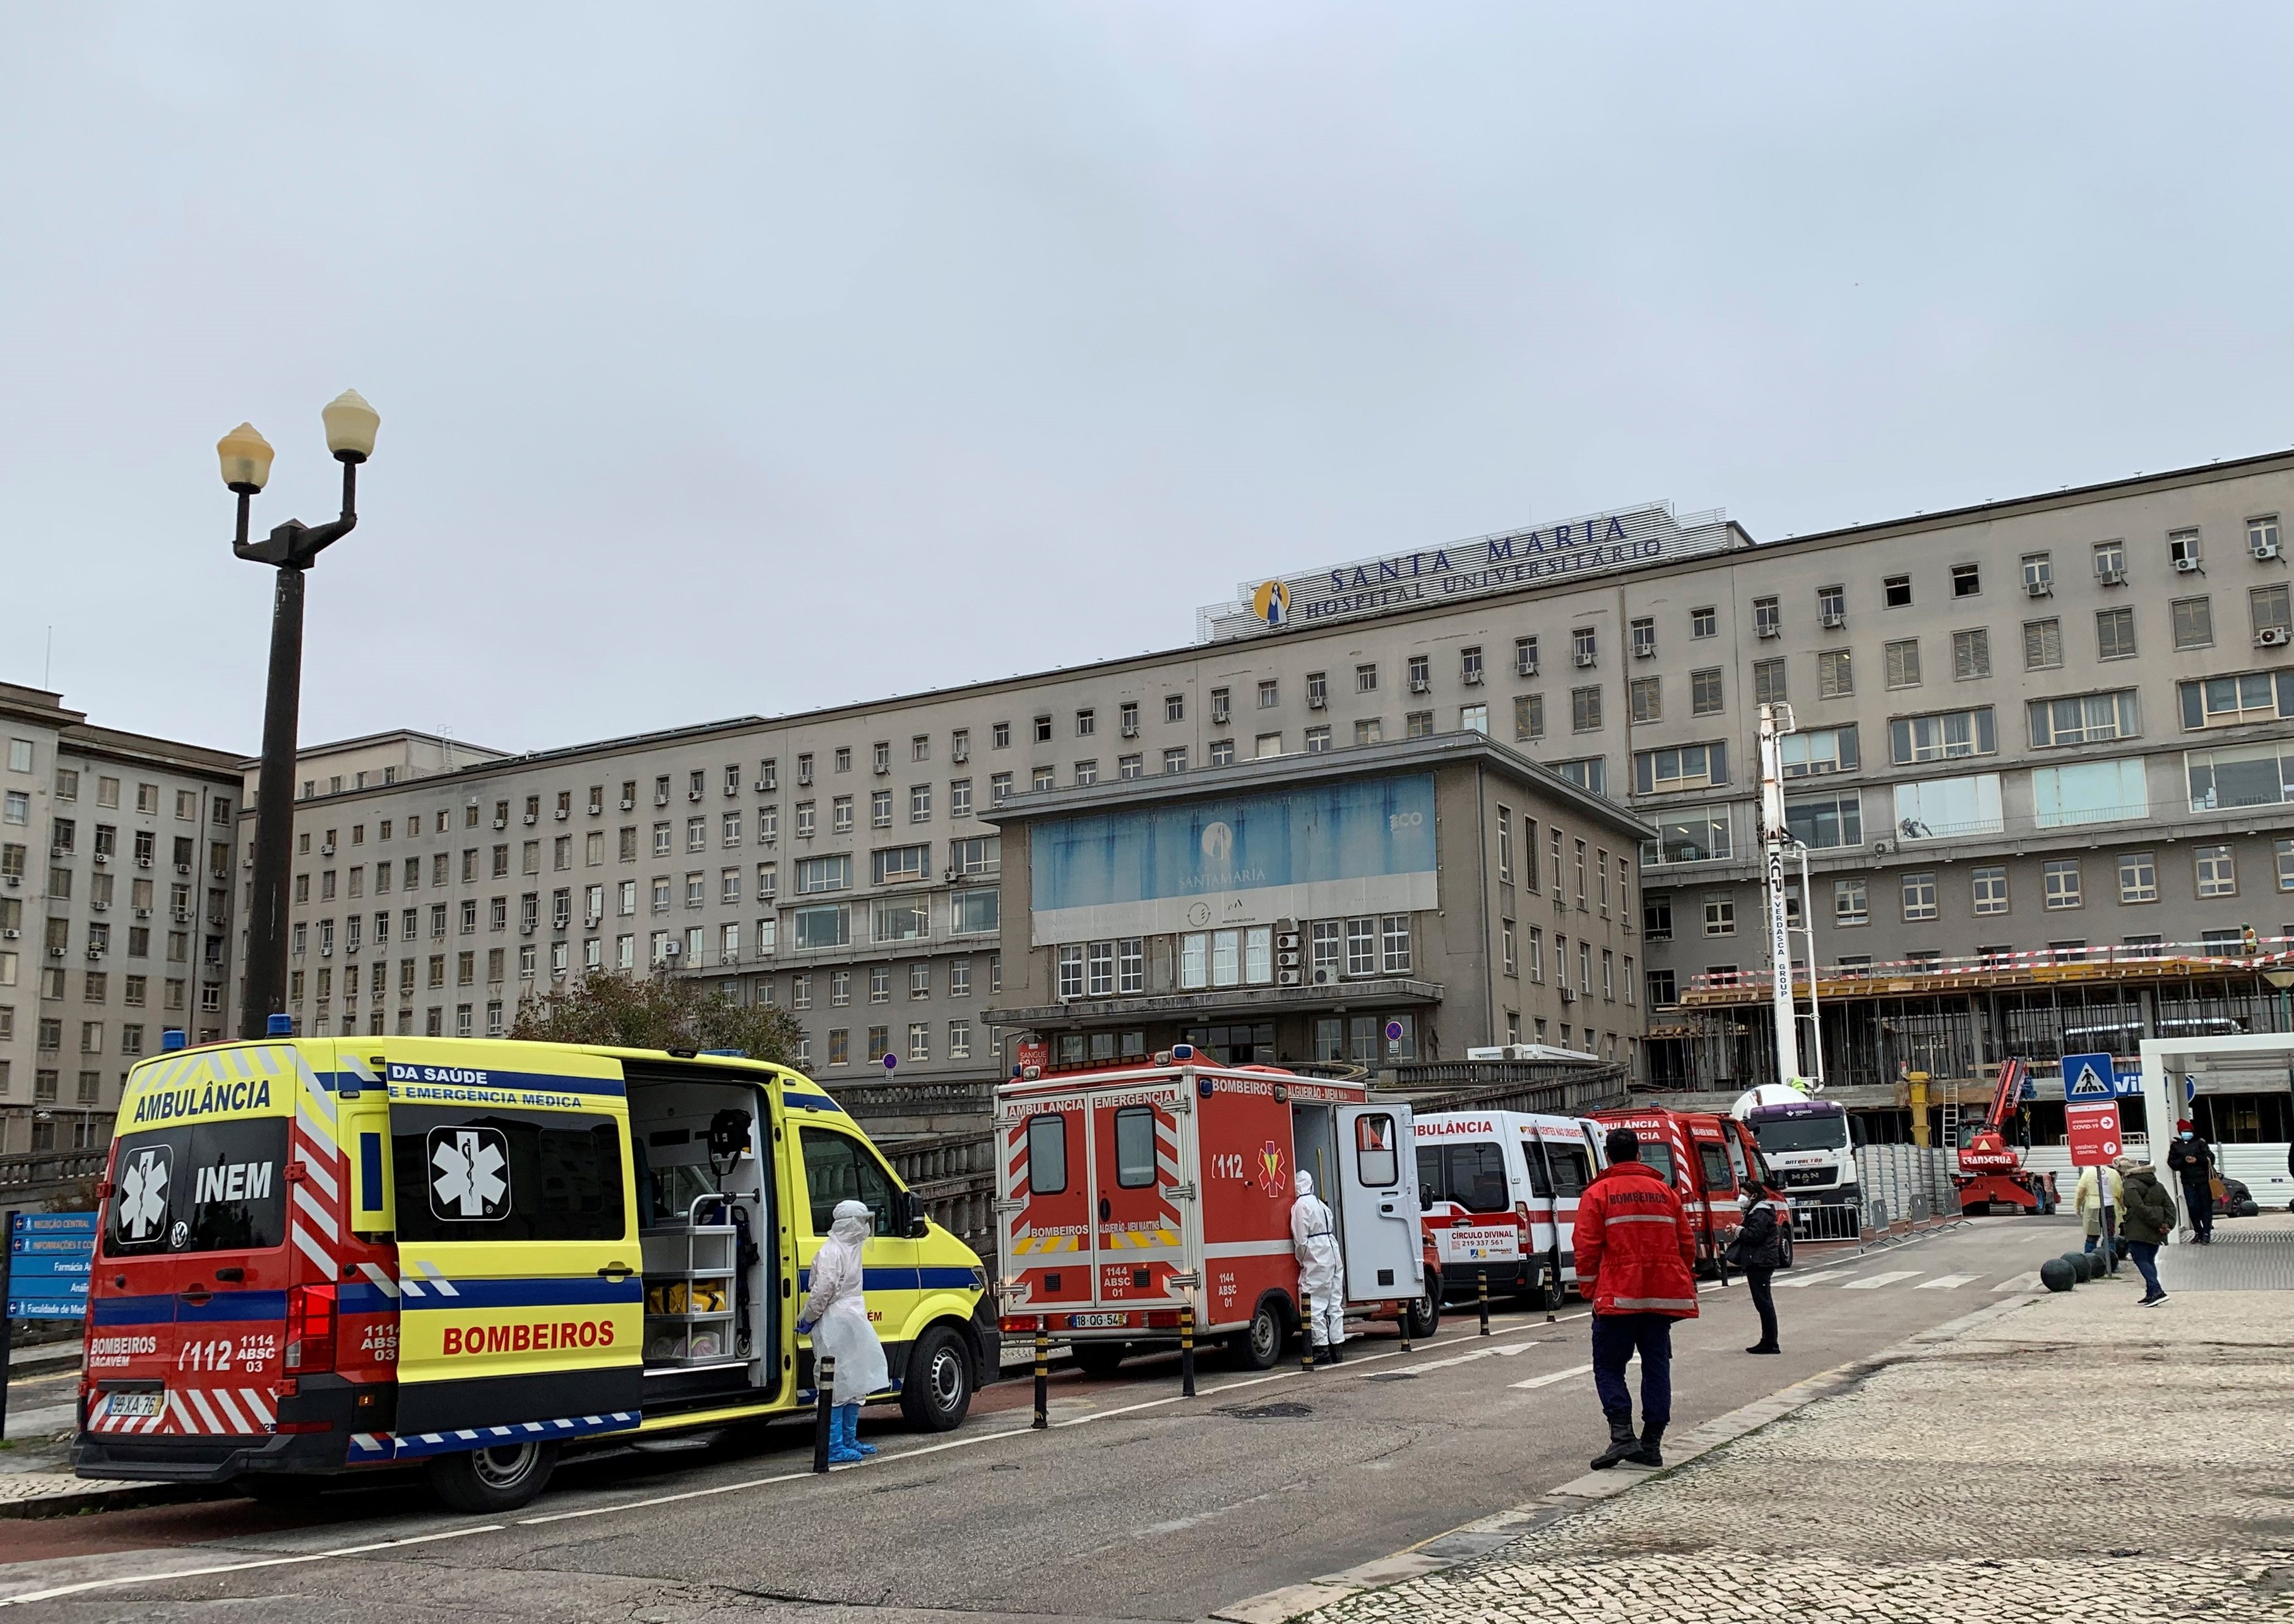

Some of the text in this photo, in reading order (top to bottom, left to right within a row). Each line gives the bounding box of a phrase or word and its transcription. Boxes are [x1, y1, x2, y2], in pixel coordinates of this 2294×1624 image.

[1330, 515, 1628, 592] SANTA MARIA
[1305, 537, 1661, 619] HOSPITAL UNIVERSITÁRIO
[1769, 851, 1782, 893] KCP
[1774, 902, 1788, 997] VERDASCA GROUP
[1020, 1050, 1047, 1059] SANGUE
[392, 1065, 488, 1084] DA SAÚDE
[1211, 1078, 1274, 1096] BOMBEIROS
[1287, 1084, 1322, 1099] ALGUEIRÃO
[1325, 1088, 1338, 1100] MEM
[133, 1080, 271, 1123] AMBULÂNCIA
[389, 1086, 582, 1108] E EMERGÊNCIA MÉDICA
[1009, 1090, 1173, 1117] AMBULANCIA EMERGENCIA
[1413, 1120, 1494, 1137] BULÂNCIA
[1218, 1154, 1244, 1178] 112
[1792, 1171, 1820, 1180] MAN
[194, 1161, 273, 1204] INEM
[1610, 1192, 1667, 1205] BOMBEIROS
[1031, 1224, 1089, 1237] BOMBEIROS
[1098, 1221, 1125, 1234] ALGUEIRÃO
[1127, 1222, 1139, 1232] MEM
[1139, 1220, 1160, 1231] MARTINS
[1451, 1230, 1514, 1240] CÍRCULO DIVINAL
[54, 1262, 83, 1271] Farmácia
[1106, 1267, 1127, 1276] 1144
[1104, 1277, 1131, 1287] ABSC
[1219, 1272, 1235, 1284] 1144
[1112, 1287, 1124, 1298] 01
[1218, 1284, 1237, 1296] ABSC
[27, 1303, 59, 1314] Faculdade
[60, 1303, 69, 1314] de
[1224, 1297, 1233, 1308] 01
[241, 1334, 275, 1348] 1114
[360, 1337, 400, 1350] ABS
[443, 1320, 614, 1356] BOMBEIROS
[90, 1336, 157, 1356] BOMBEIROS
[190, 1340, 232, 1372] 112
[236, 1348, 276, 1361] ABSC
[374, 1349, 395, 1361] 03
[90, 1355, 130, 1368] SACAVÉM
[246, 1361, 263, 1373] 03
